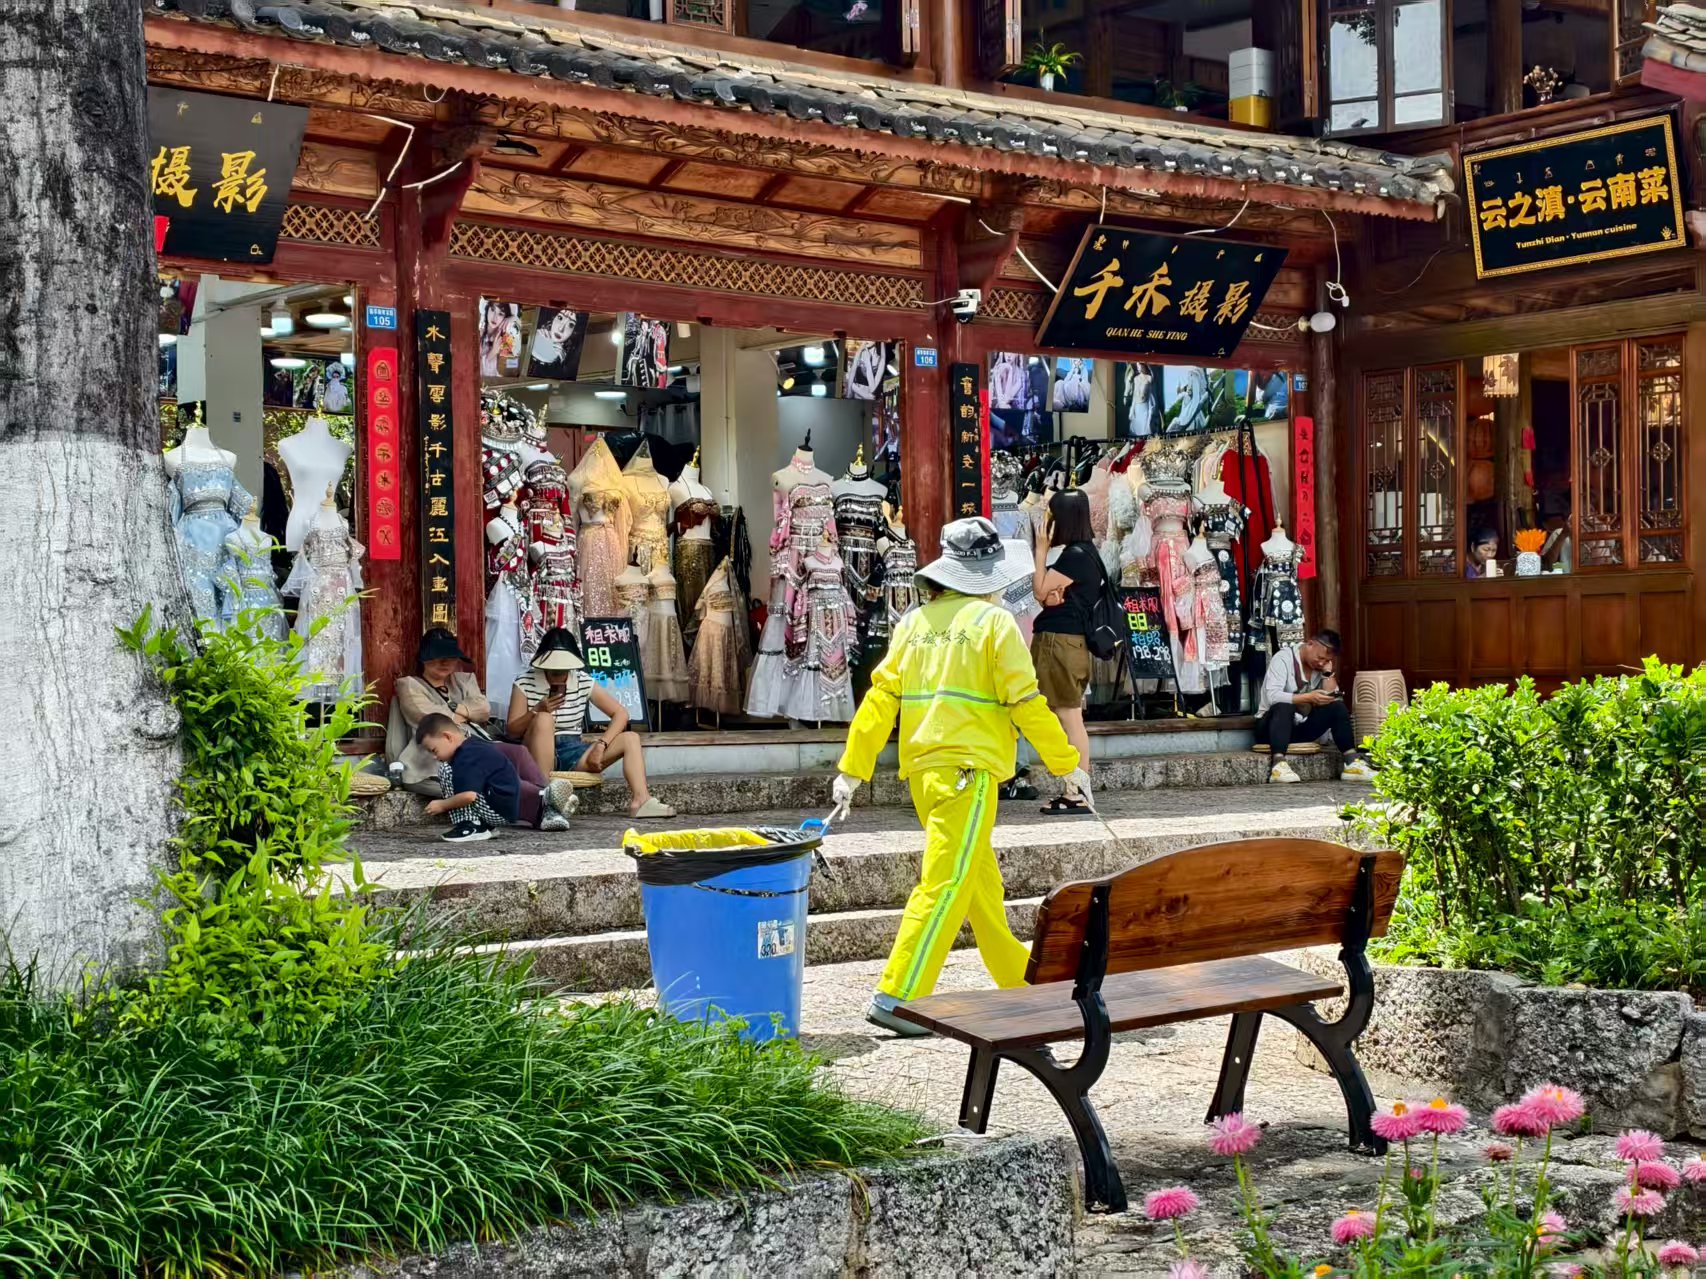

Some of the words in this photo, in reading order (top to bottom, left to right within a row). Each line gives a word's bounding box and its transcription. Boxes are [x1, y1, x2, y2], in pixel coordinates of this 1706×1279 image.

[151, 145, 268, 214] 摄影
[1480, 165, 1669, 231] 云之滇·云南菜
[1516, 238, 1544, 250] Yunzhi
[1545, 234, 1565, 245] Dian
[1570, 228, 1604, 240] Yunnan
[1604, 222, 1638, 235] cuisine
[1073, 257, 1252, 326] 千禾摄影
[373, 316, 391, 327] 105
[1105, 326, 1131, 338] QIAN
[1130, 328, 1145, 338] HE
[1145, 329, 1167, 340] SHE
[1165, 331, 1189, 341] YING
[1127, 612, 1148, 631] 88
[587, 646, 612, 667] 88
